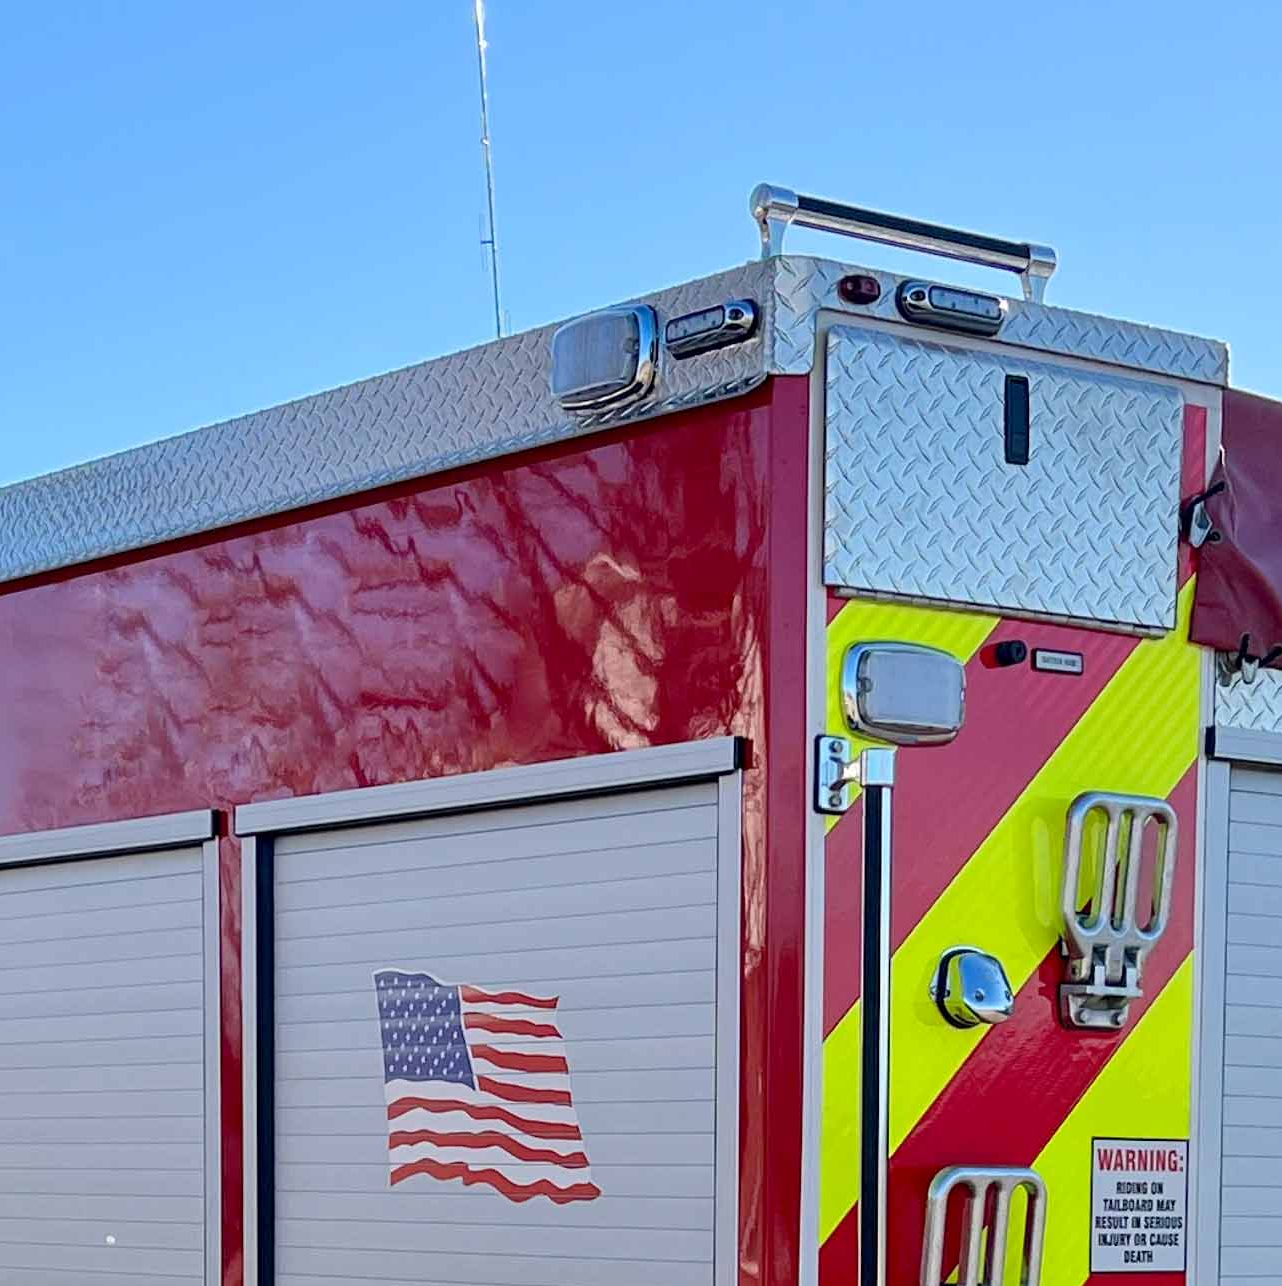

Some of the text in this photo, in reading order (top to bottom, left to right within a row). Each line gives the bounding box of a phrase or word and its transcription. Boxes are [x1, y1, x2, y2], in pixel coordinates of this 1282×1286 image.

[1097, 1149, 1183, 1172] WARNING:
[1116, 1182, 1163, 1194] RIDING ON
[1103, 1199, 1176, 1212] TAILBOARD MAY
[1095, 1216, 1183, 1229] RESULT IN SERIOUS
[1098, 1233, 1179, 1246] INJURY OR CAUSE
[1124, 1250, 1153, 1263] DEATH
